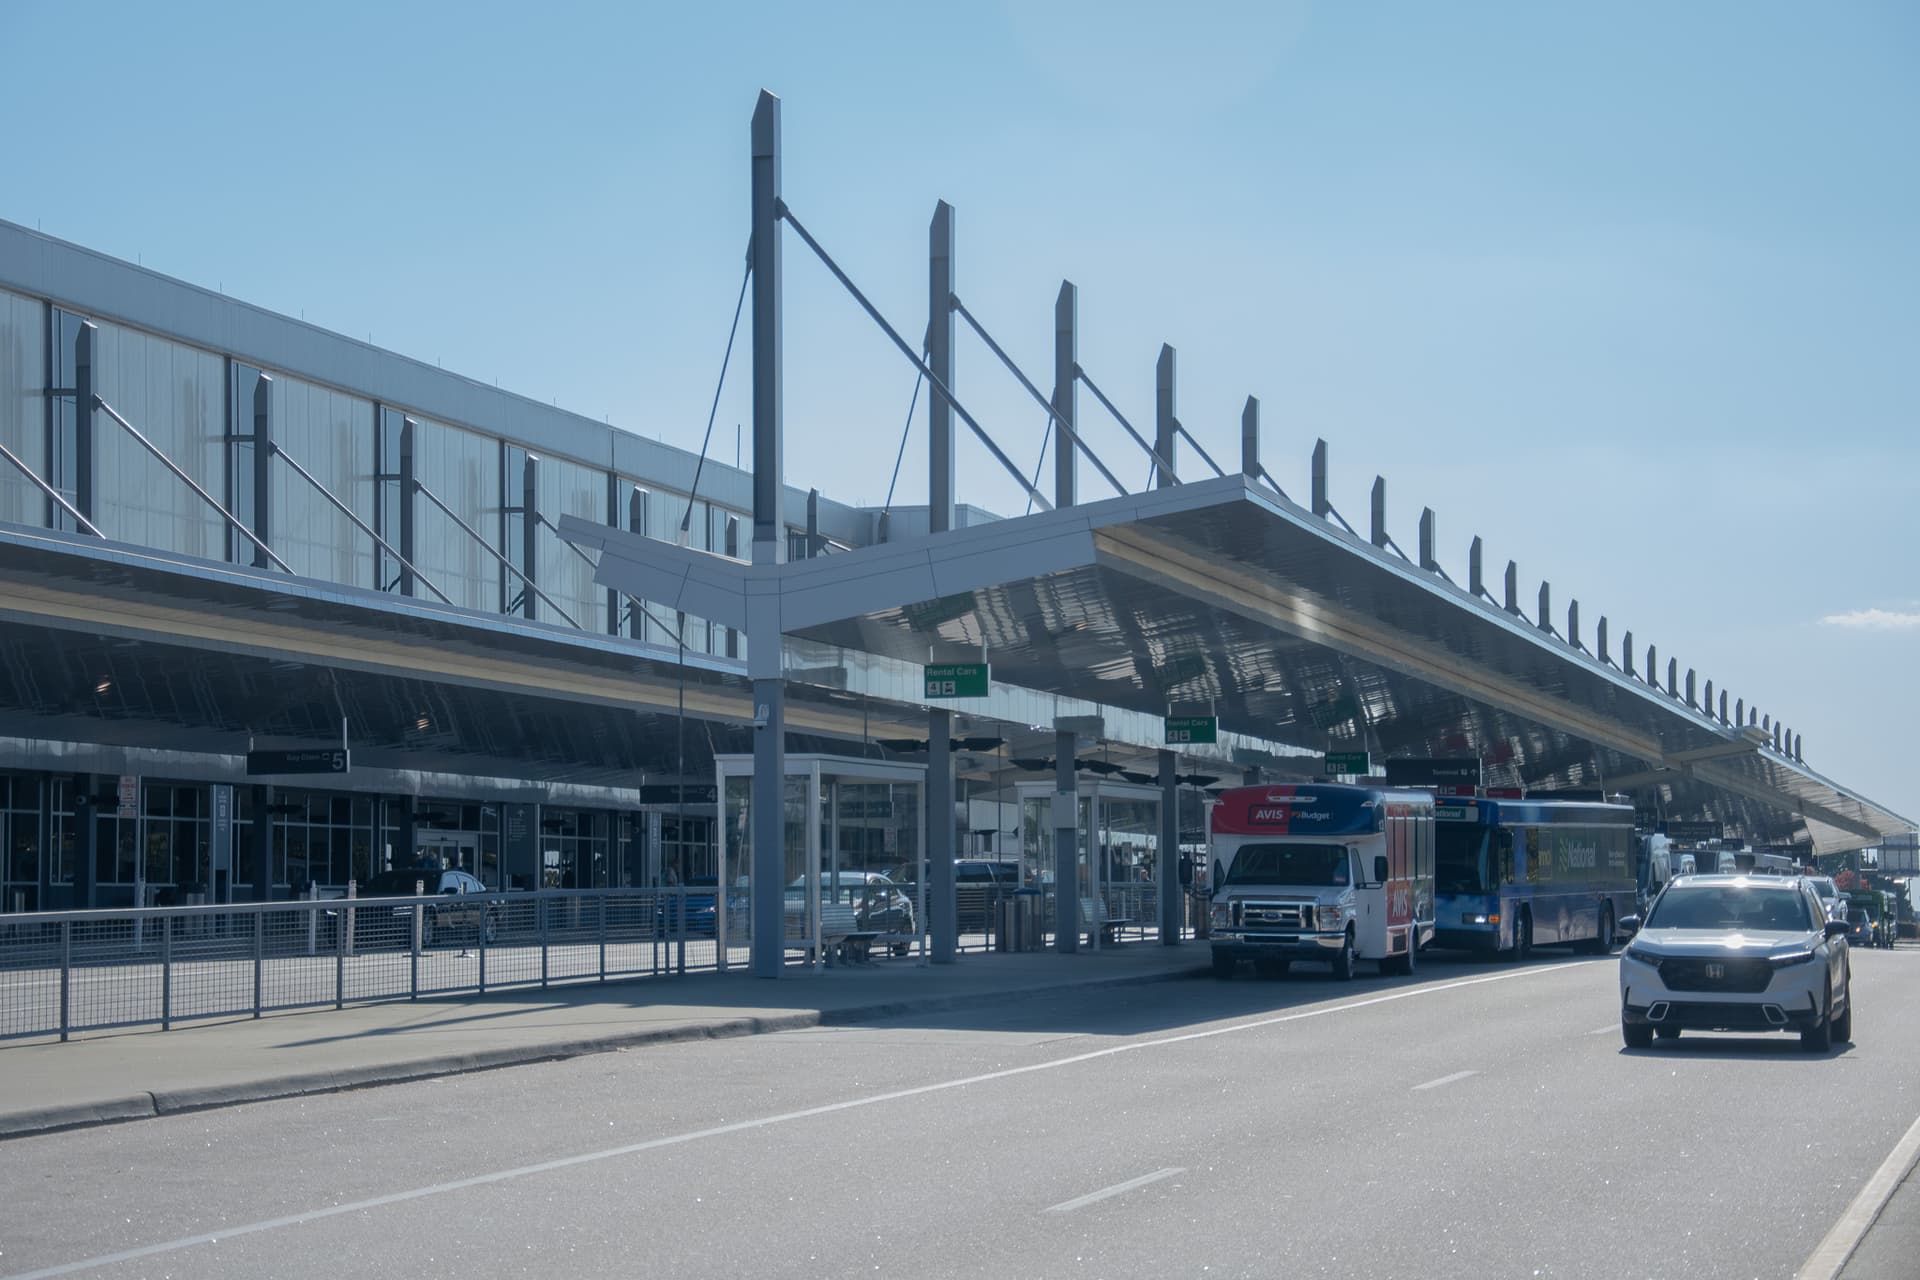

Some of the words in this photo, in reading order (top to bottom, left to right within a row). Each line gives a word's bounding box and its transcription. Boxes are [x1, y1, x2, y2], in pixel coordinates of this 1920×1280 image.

[927, 668, 954, 676] Rental
[957, 668, 977, 676] Cars
[332, 752, 344, 769] 5
[706, 788, 716, 801] 4
[1255, 809, 1284, 820] AVIS
[1301, 811, 1330, 822] Budget
[1435, 810, 1462, 818] ational
[1567, 841, 1597, 869] National
[1392, 887, 1409, 918] AVIS
